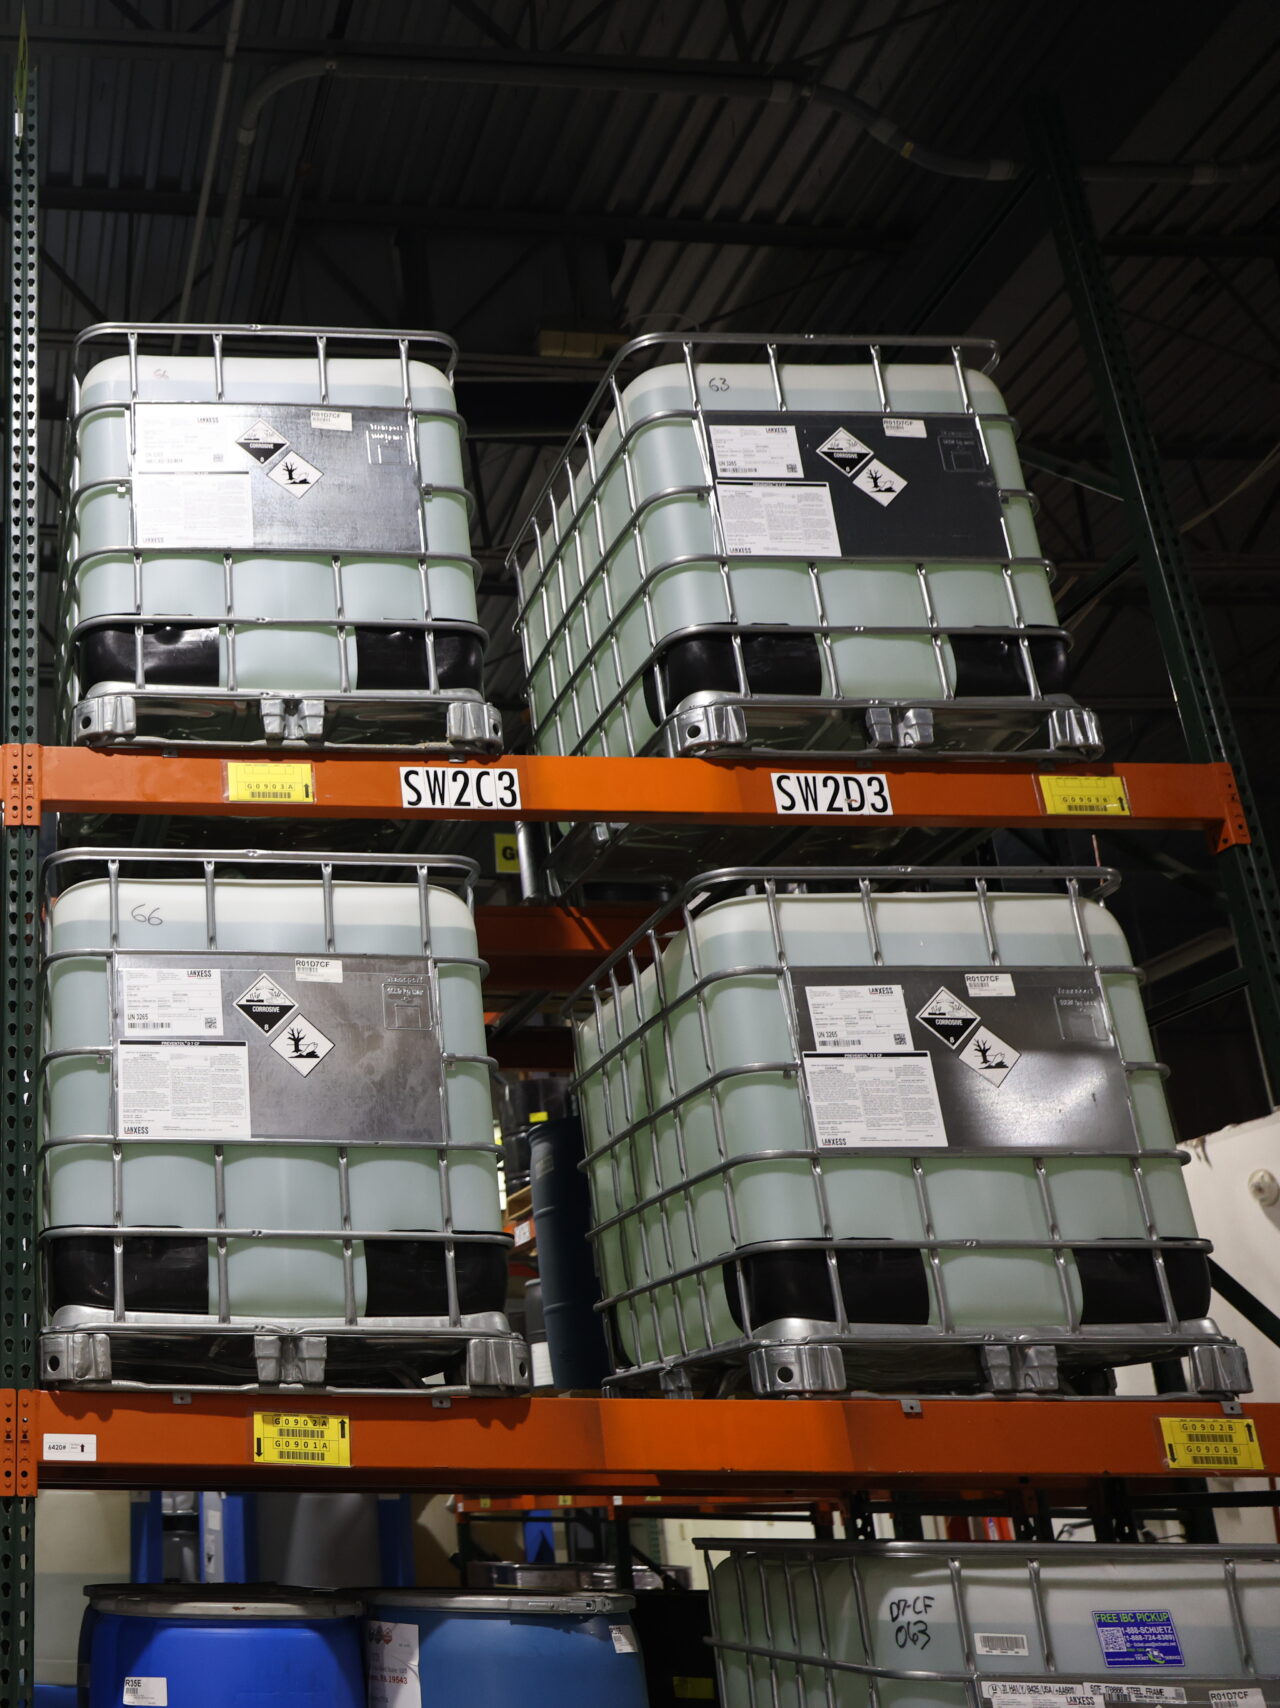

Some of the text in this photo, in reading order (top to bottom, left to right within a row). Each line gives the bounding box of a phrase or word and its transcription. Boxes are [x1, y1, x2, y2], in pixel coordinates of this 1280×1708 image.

[708, 377, 730, 392] 63
[404, 770, 517, 808] SW2C3
[776, 774, 888, 813] SW2D3
[131, 903, 164, 926] 66
[296, 960, 330, 968] R01D7CF
[186, 970, 212, 978] LANXESS
[966, 975, 1000, 983] R01D7CF
[868, 986, 894, 994] LANXESS
[935, 1018, 963, 1026] CORROSIVE
[822, 1138, 846, 1146] LANXESS
[1095, 1612, 1168, 1623] FREE IBC PICKUP
[894, 1620, 931, 1650] 063
[126, 1680, 142, 1688] R35E
[1066, 1696, 1095, 1705] LANXESS
[1210, 1691, 1248, 1701] R01D7CF
